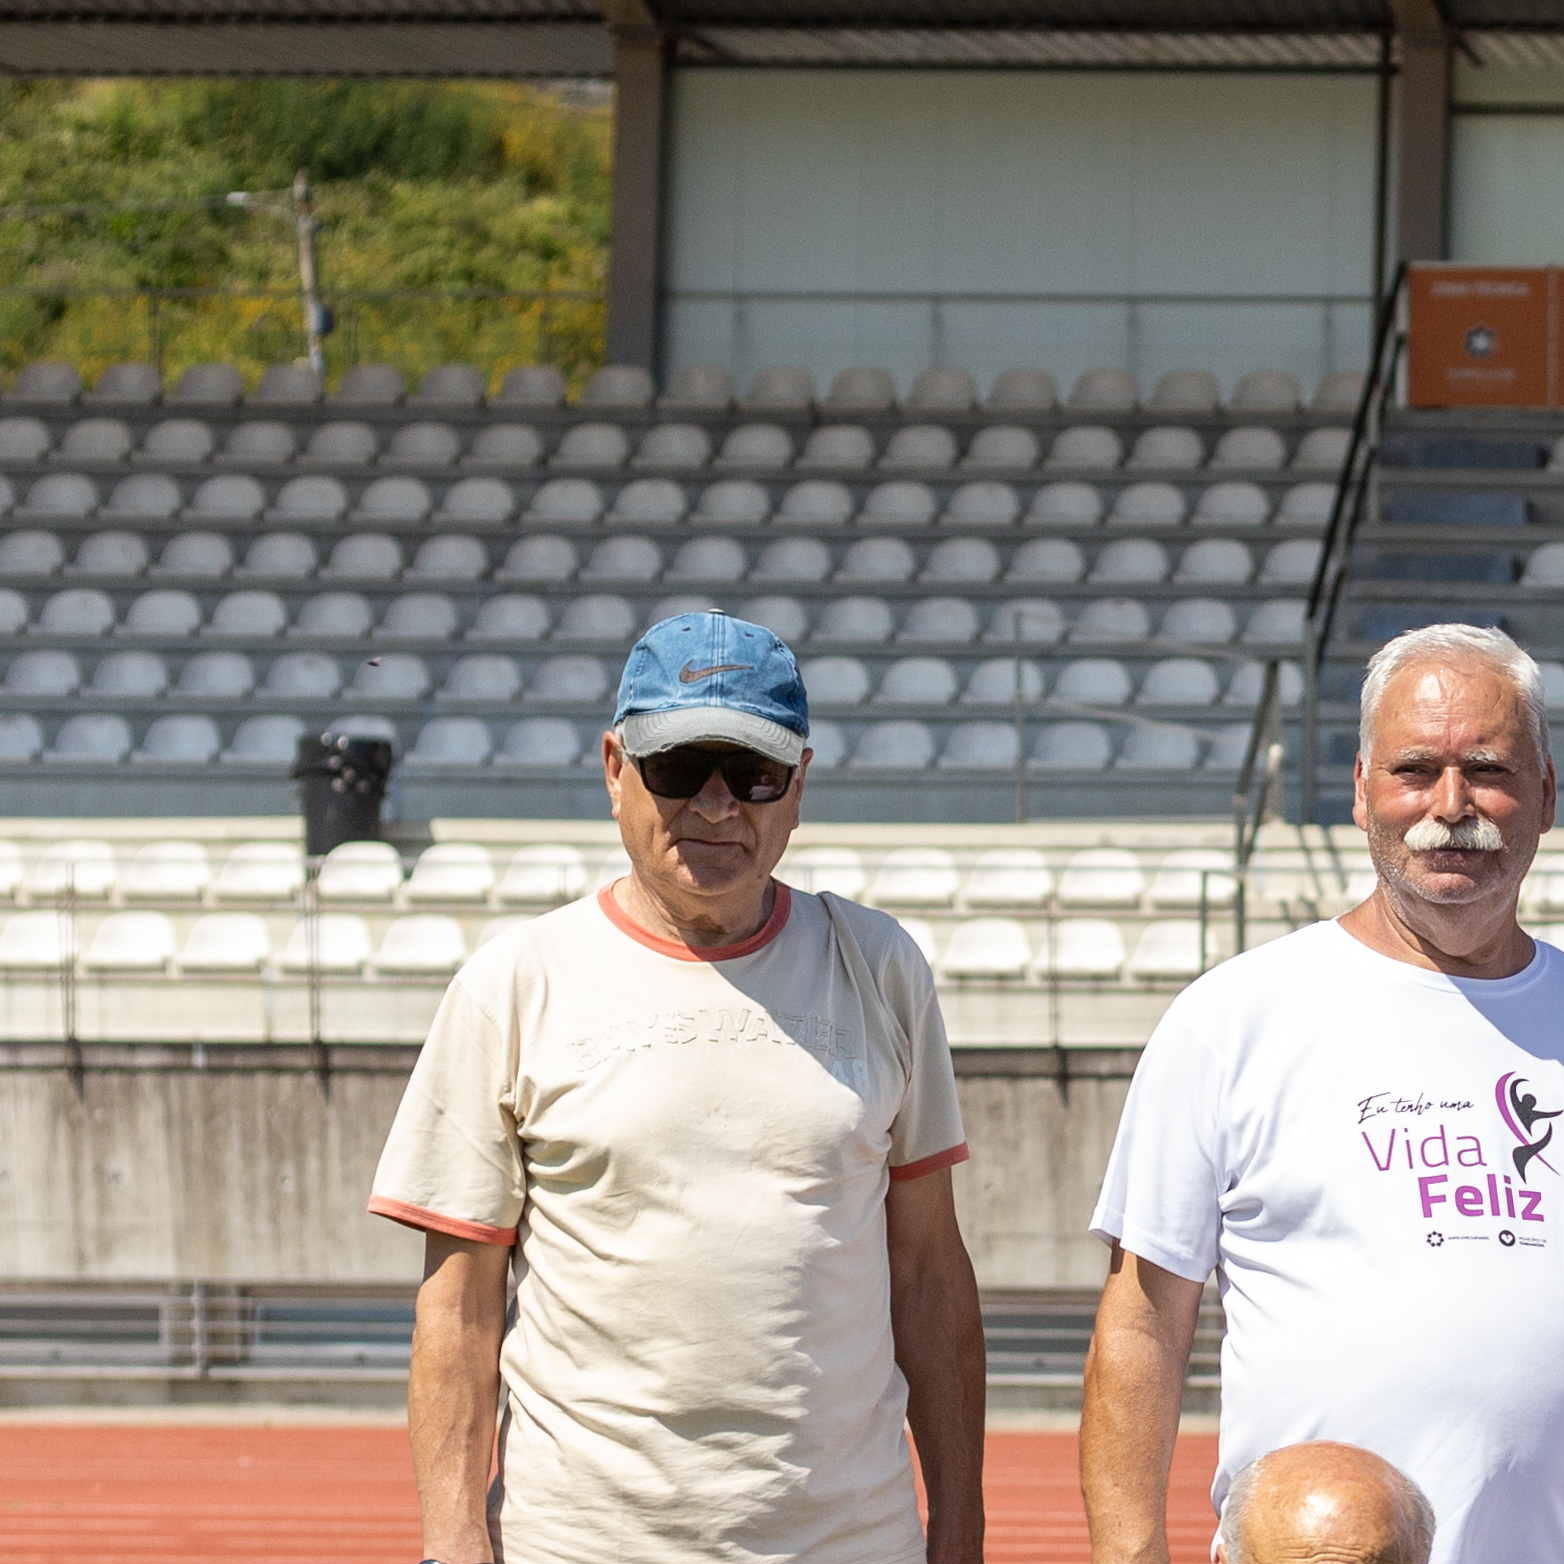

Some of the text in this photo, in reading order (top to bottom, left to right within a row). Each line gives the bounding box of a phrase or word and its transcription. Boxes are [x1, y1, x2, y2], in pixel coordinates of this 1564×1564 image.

[1358, 1091, 1474, 1124] Eu tenho uma
[1361, 1124, 1488, 1172] Vida
[1418, 1173, 1545, 1222] Feliz
